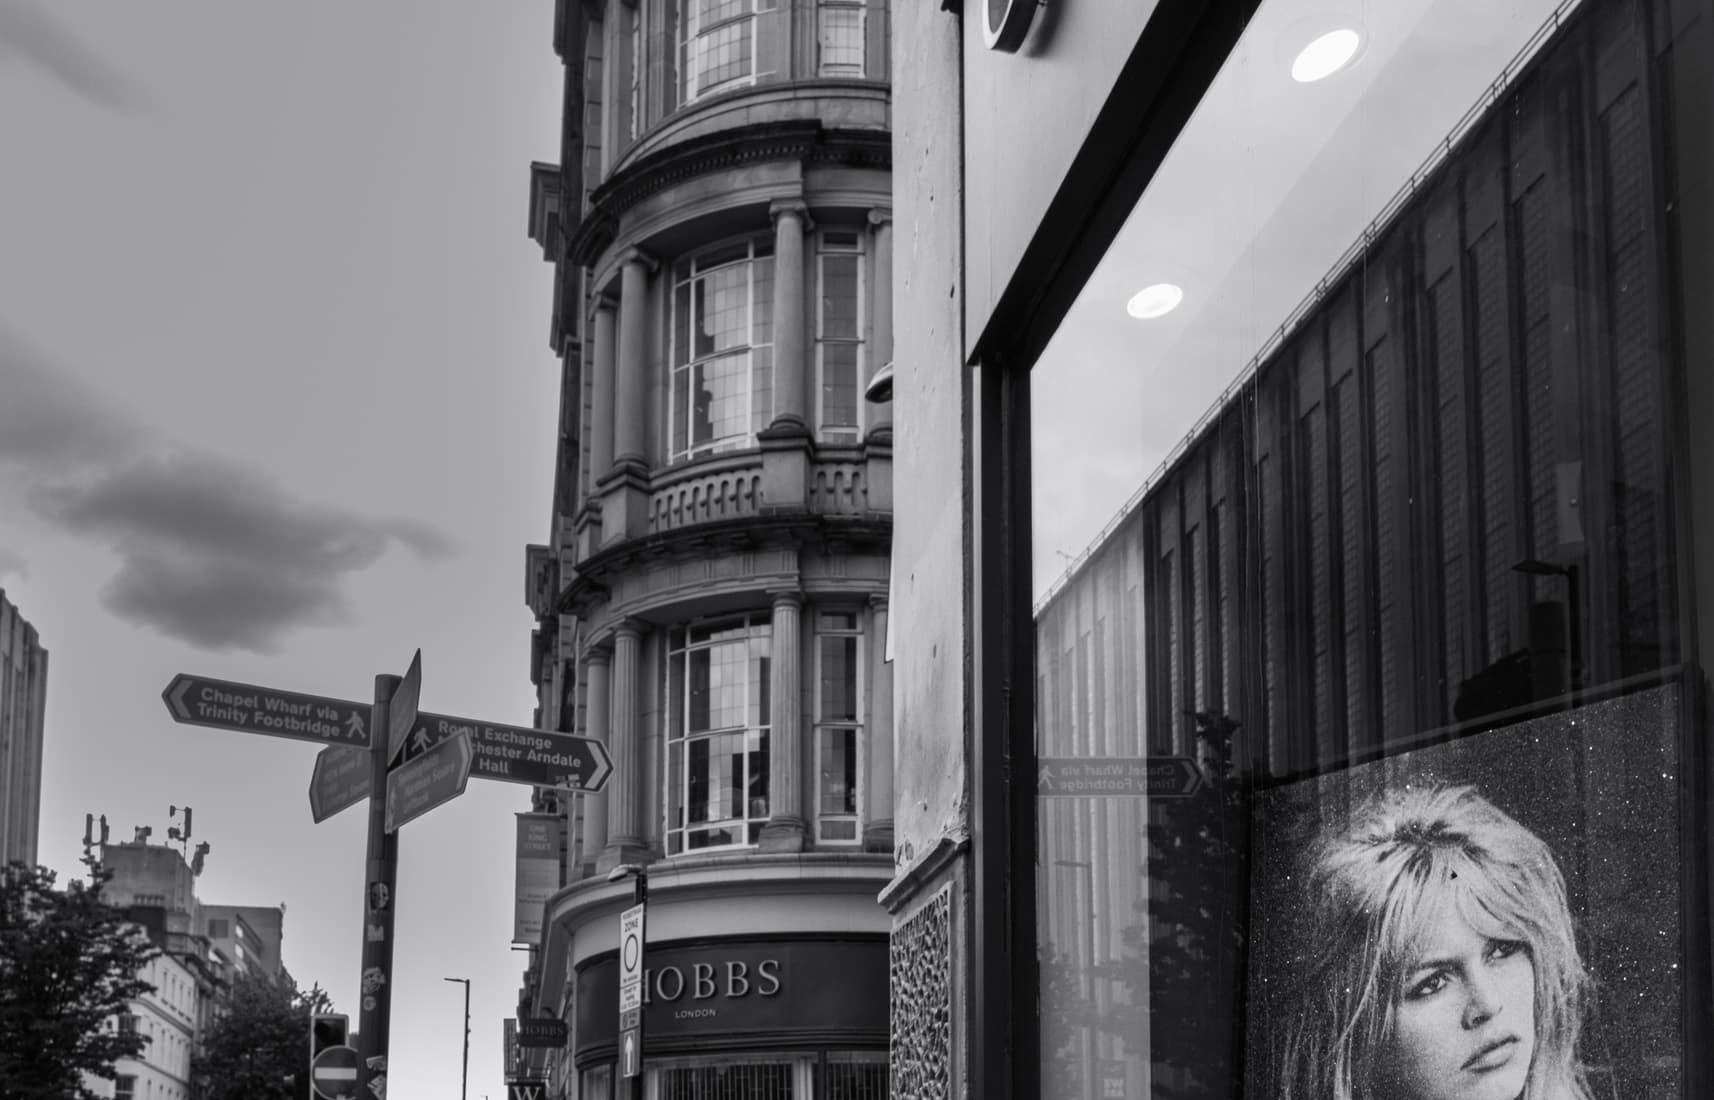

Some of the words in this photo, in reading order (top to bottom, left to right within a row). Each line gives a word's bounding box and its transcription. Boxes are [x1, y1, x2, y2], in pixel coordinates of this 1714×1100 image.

[201, 688, 258, 708] Chapel
[264, 697, 312, 716] Wharf
[317, 706, 339, 721] via
[198, 702, 248, 724] Trinity
[254, 712, 340, 737] Footbridge
[438, 720, 478, 738] Rol
[485, 728, 552, 750] Exchange
[479, 758, 509, 774] Hall
[527, 749, 581, 768] Arndale
[675, 1008, 716, 1019] LONDON
